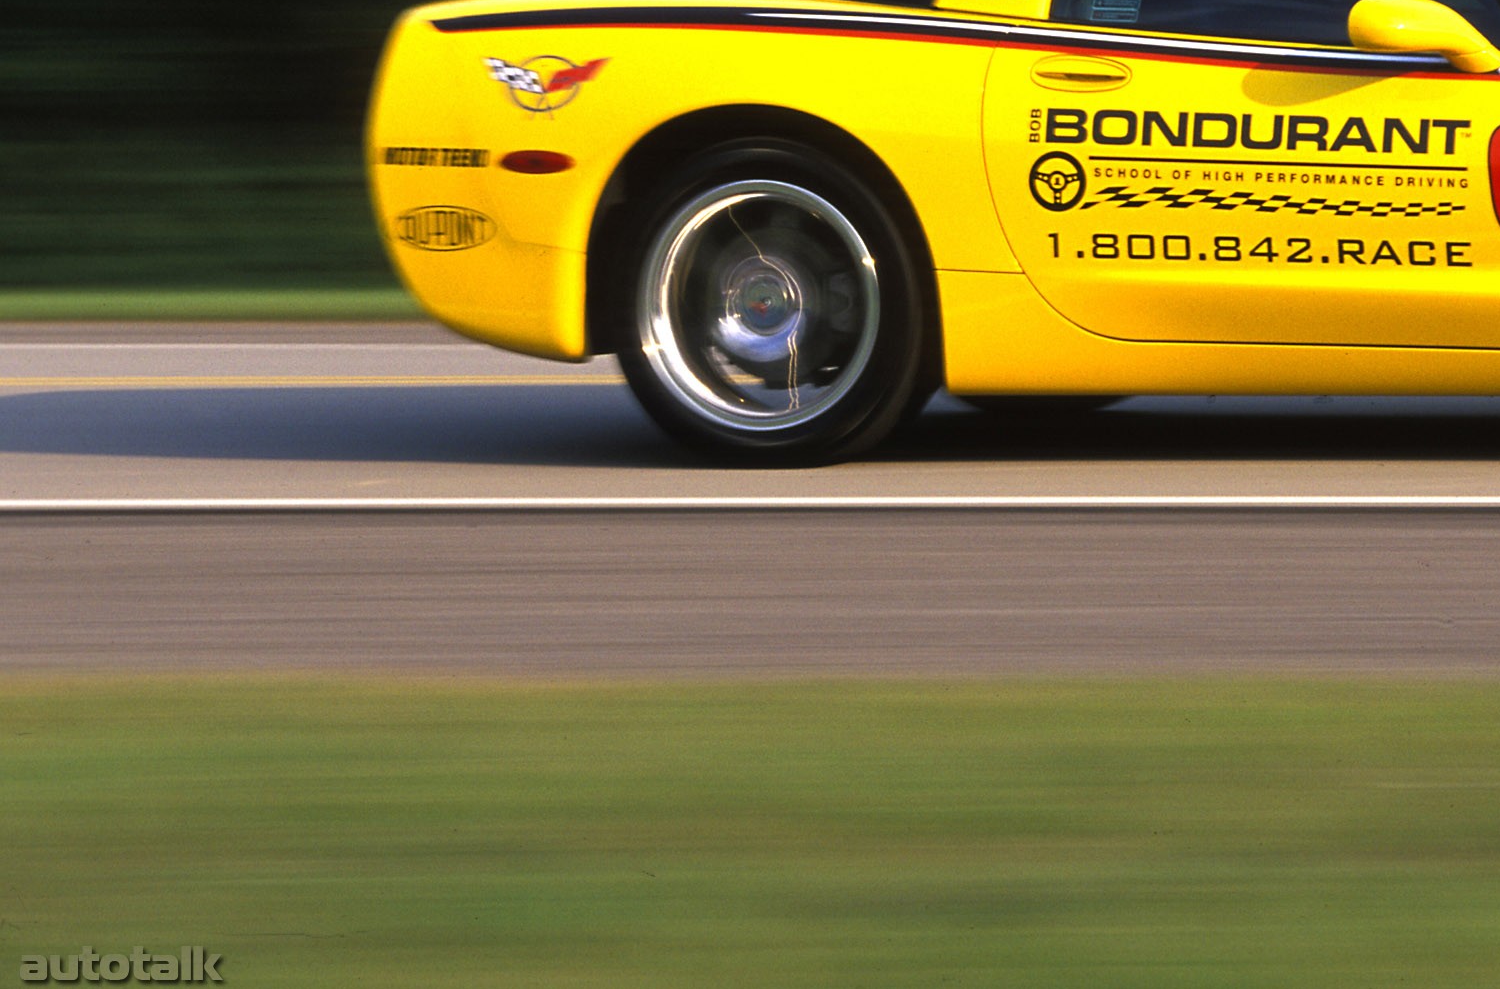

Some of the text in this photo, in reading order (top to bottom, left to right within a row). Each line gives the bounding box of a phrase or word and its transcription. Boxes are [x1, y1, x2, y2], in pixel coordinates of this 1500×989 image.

[1029, 108, 1042, 143] BOB
[1045, 108, 1471, 155] BONDURANT
[1094, 167, 1469, 188] SCHOOL OF HIGH PERFORMANCE DRIVING
[1048, 232, 1473, 267] 1.800.842.RACE
